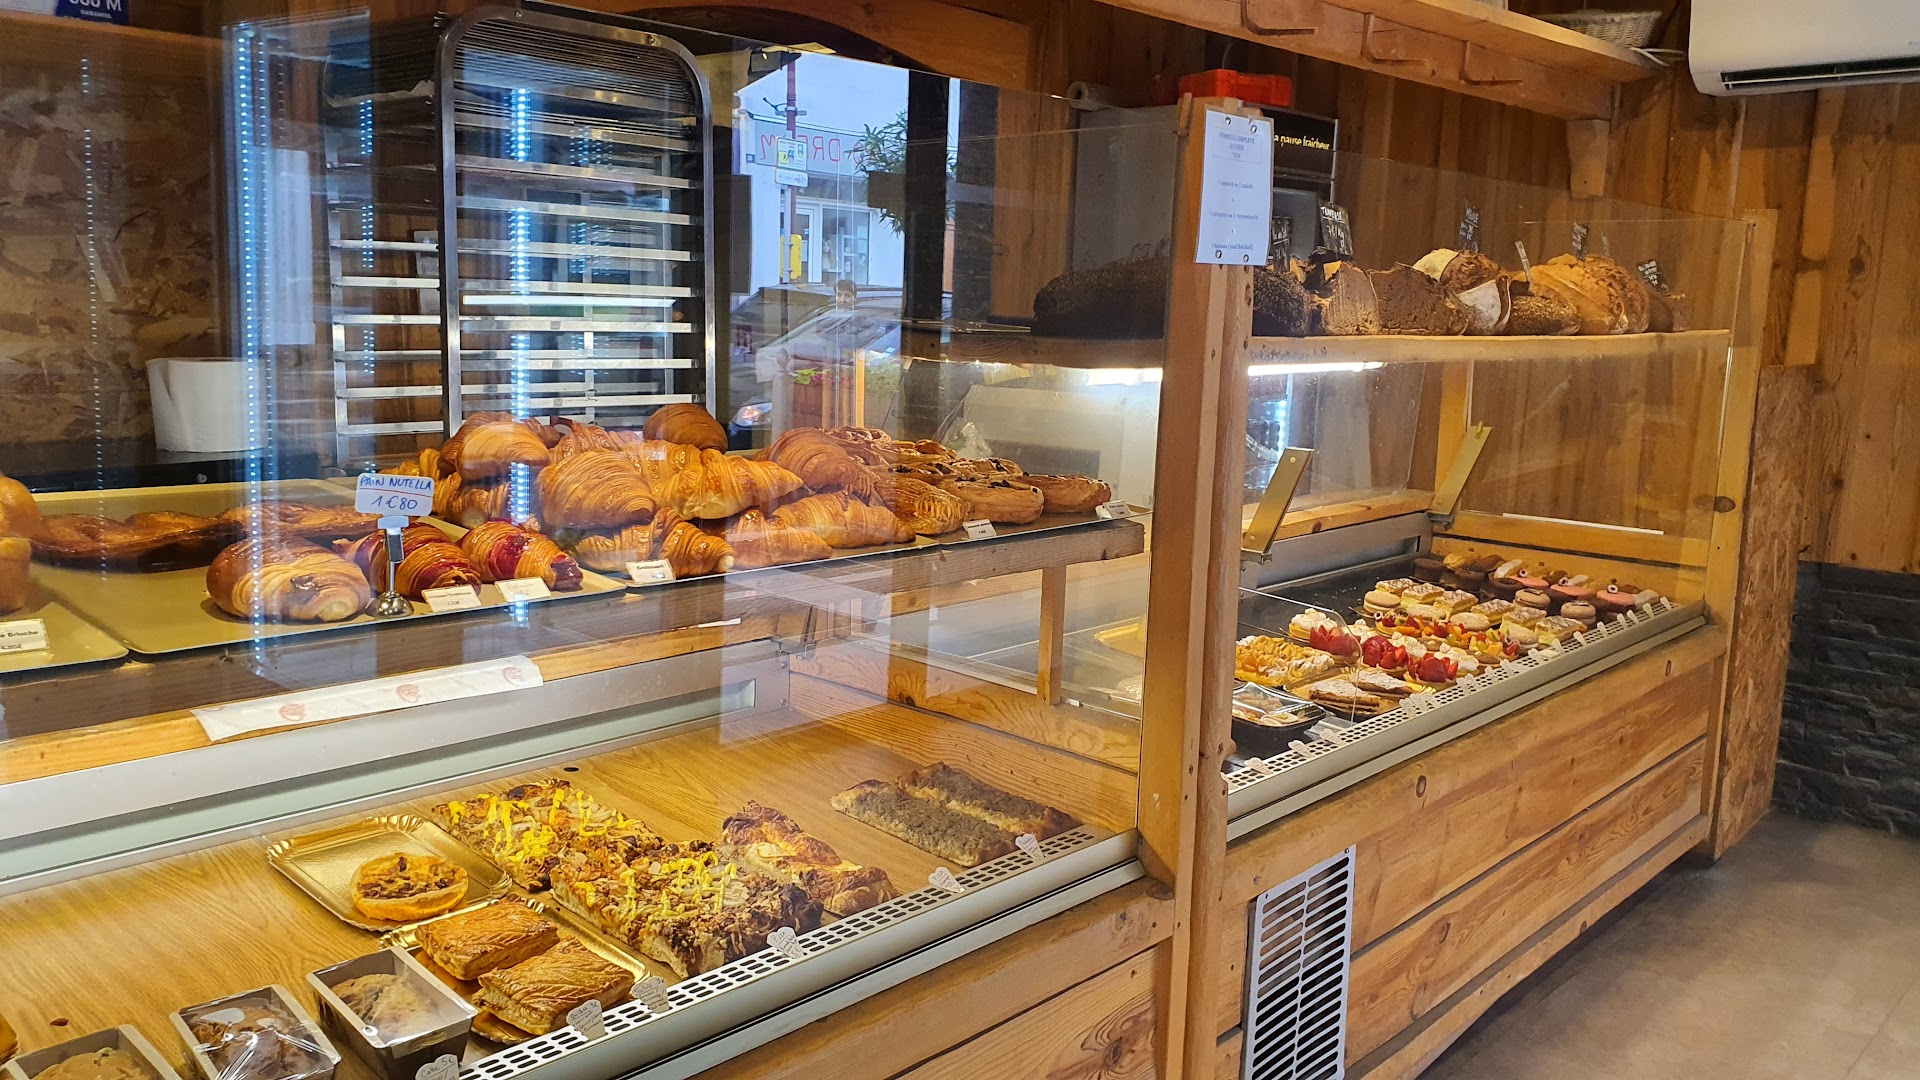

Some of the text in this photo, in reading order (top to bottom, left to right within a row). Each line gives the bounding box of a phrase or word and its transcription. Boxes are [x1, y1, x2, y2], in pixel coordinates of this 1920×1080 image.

[1280, 135, 1302, 147] pause
[360, 476, 432, 491] PAIN NUTELLA
